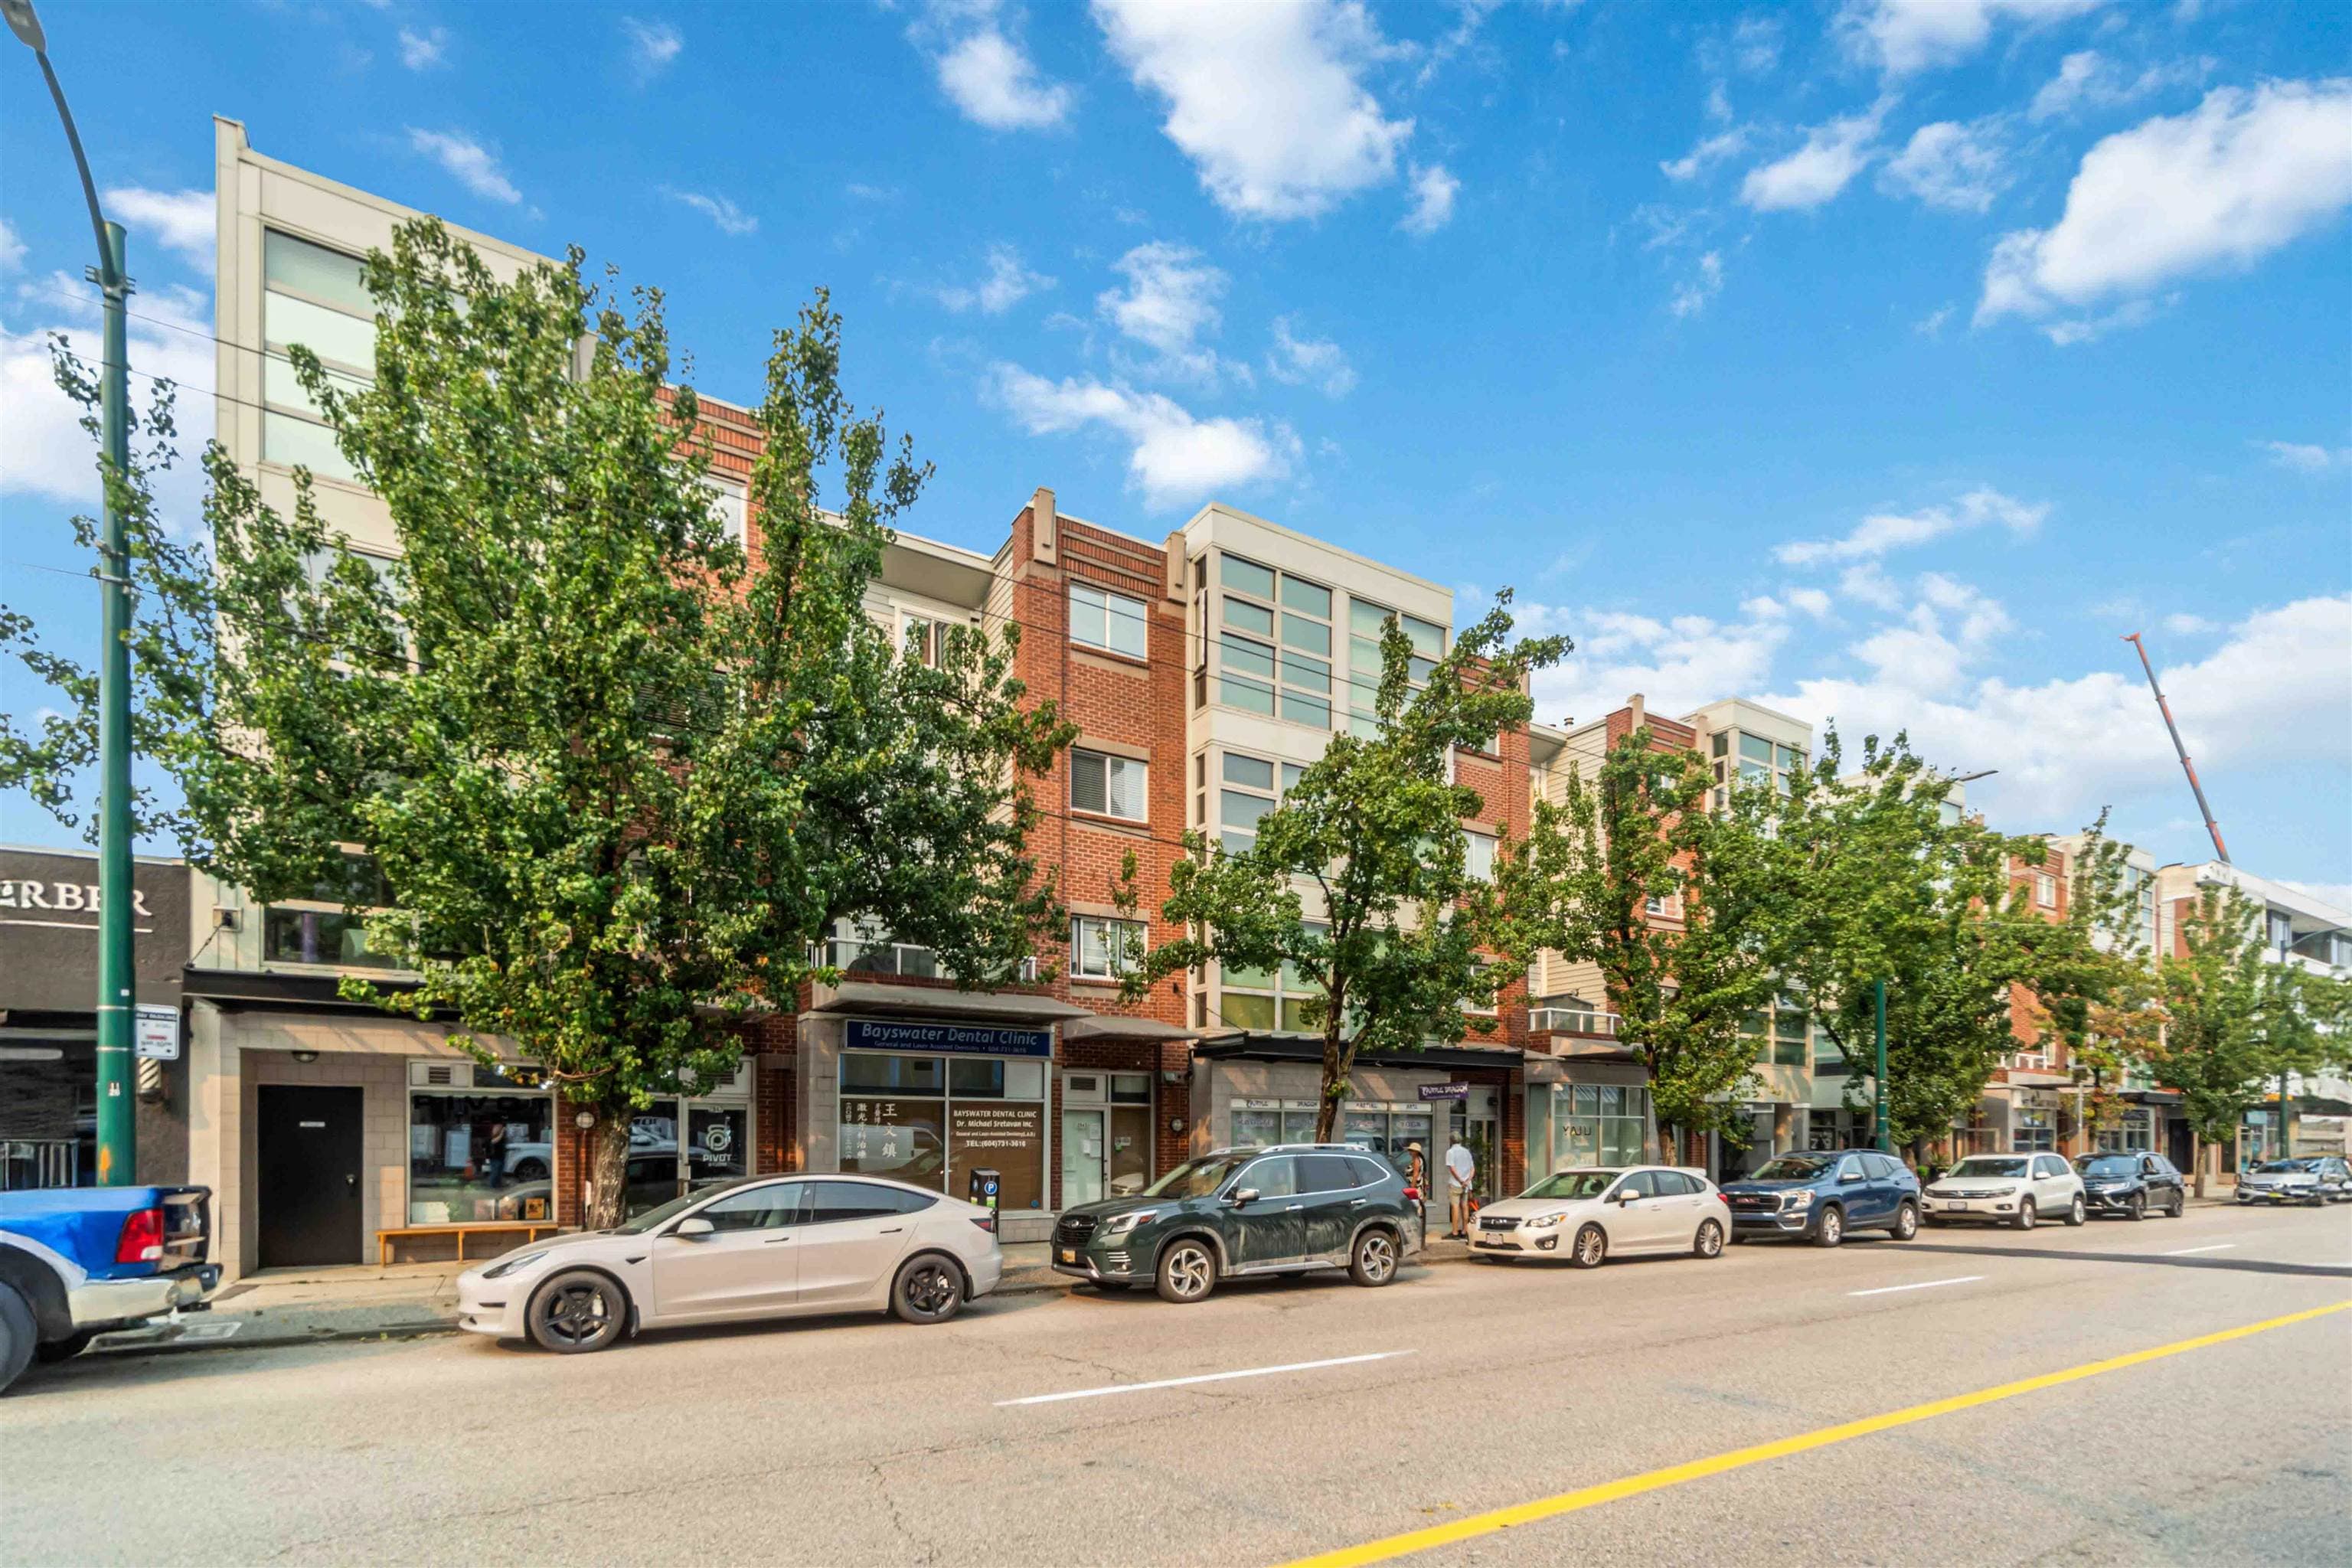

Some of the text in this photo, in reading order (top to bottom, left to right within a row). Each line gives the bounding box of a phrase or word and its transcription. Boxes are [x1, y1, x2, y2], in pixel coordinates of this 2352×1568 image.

[862, 1023, 1037, 1045] Bayswater Dental Clinic
[703, 1153, 732, 1161] PIVOT
